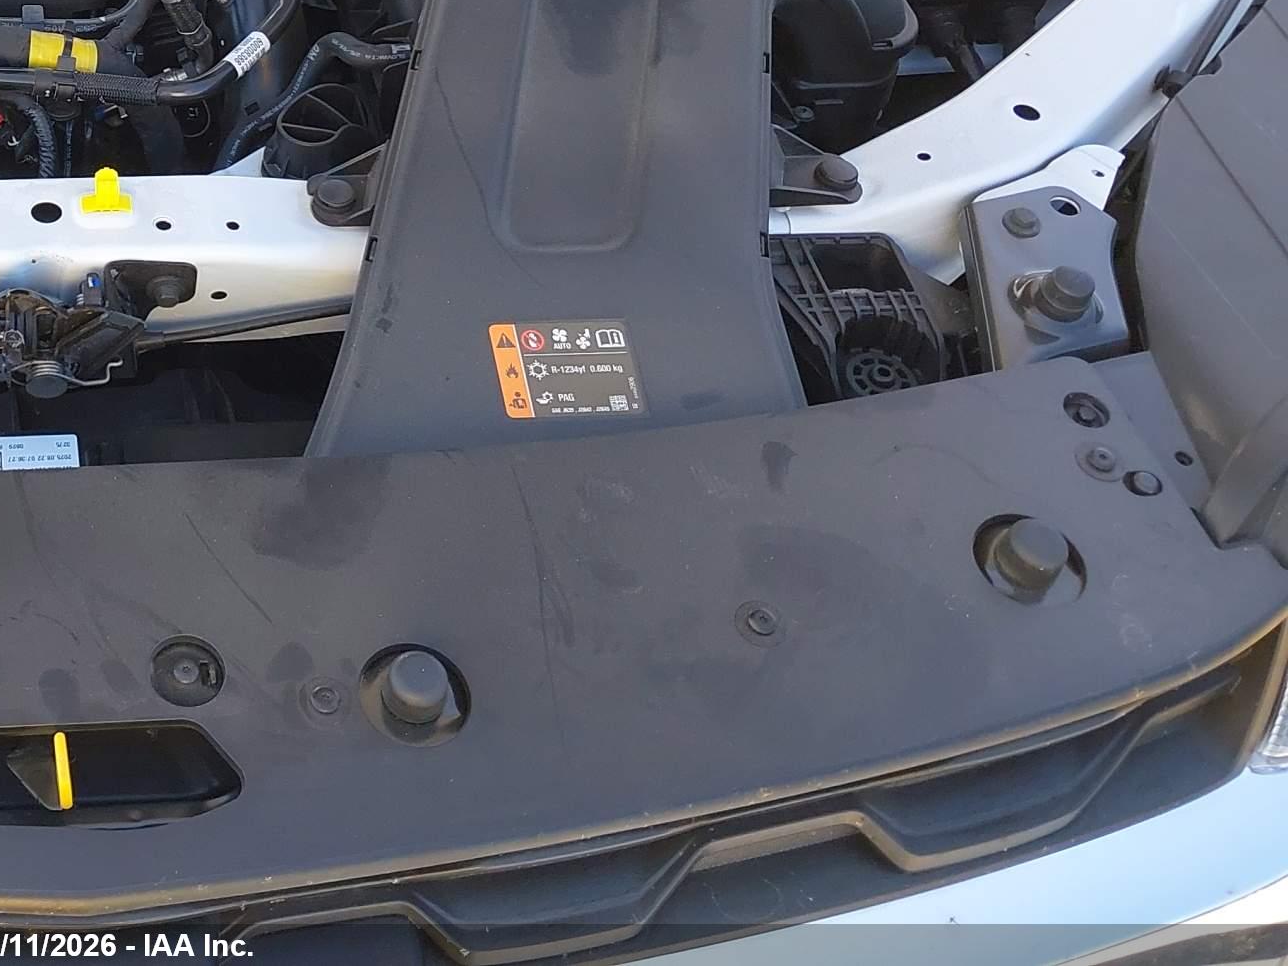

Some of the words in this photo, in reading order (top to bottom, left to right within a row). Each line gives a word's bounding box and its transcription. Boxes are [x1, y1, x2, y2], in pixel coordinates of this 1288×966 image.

[553, 341, 572, 350] AUTO
[612, 364, 624, 374] kg
[558, 393, 575, 402] PAG
